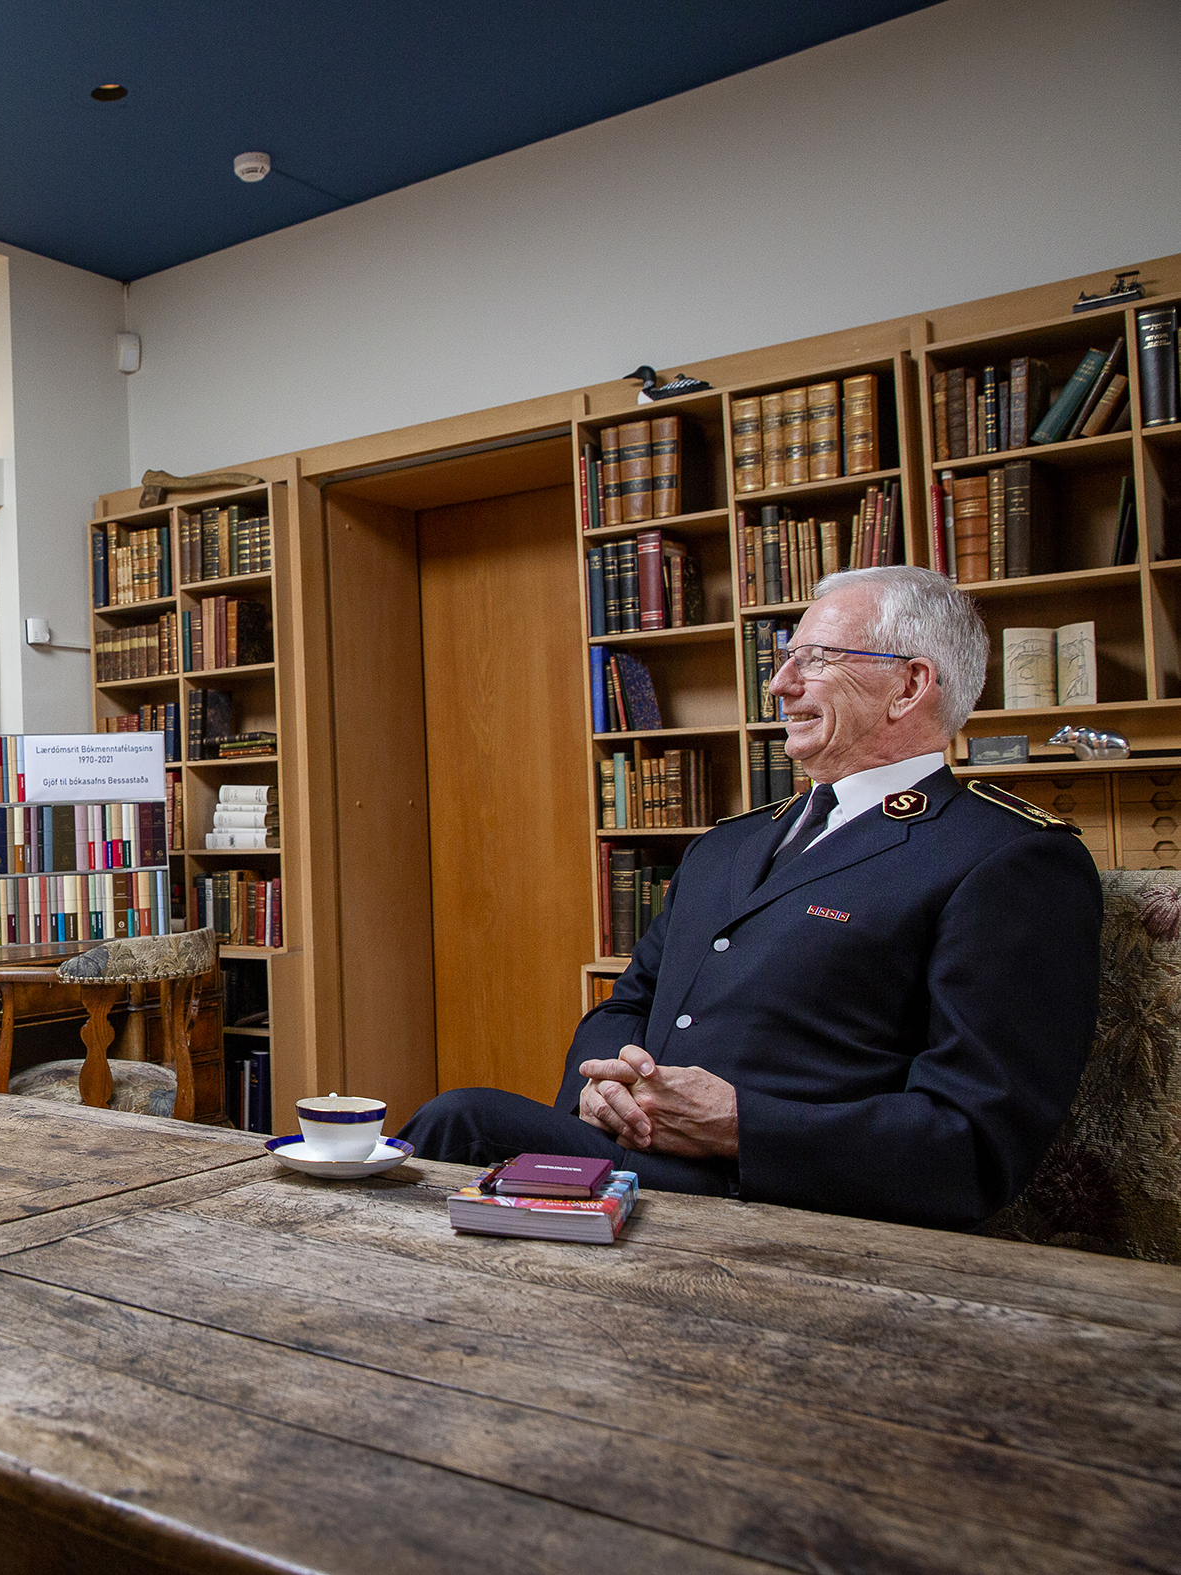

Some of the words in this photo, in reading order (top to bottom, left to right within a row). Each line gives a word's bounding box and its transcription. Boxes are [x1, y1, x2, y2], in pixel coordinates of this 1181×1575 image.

[36, 745, 79, 754] Lærdómsrit
[81, 744, 153, 754] Bókmenntafélagsins
[78, 755, 114, 763] 1970-2021
[43, 778, 58, 787] Gjöf
[59, 778, 67, 786] til
[69, 777, 106, 786] bókasafns
[108, 776, 148, 784] Bessastaða
[889, 794, 917, 810] S
